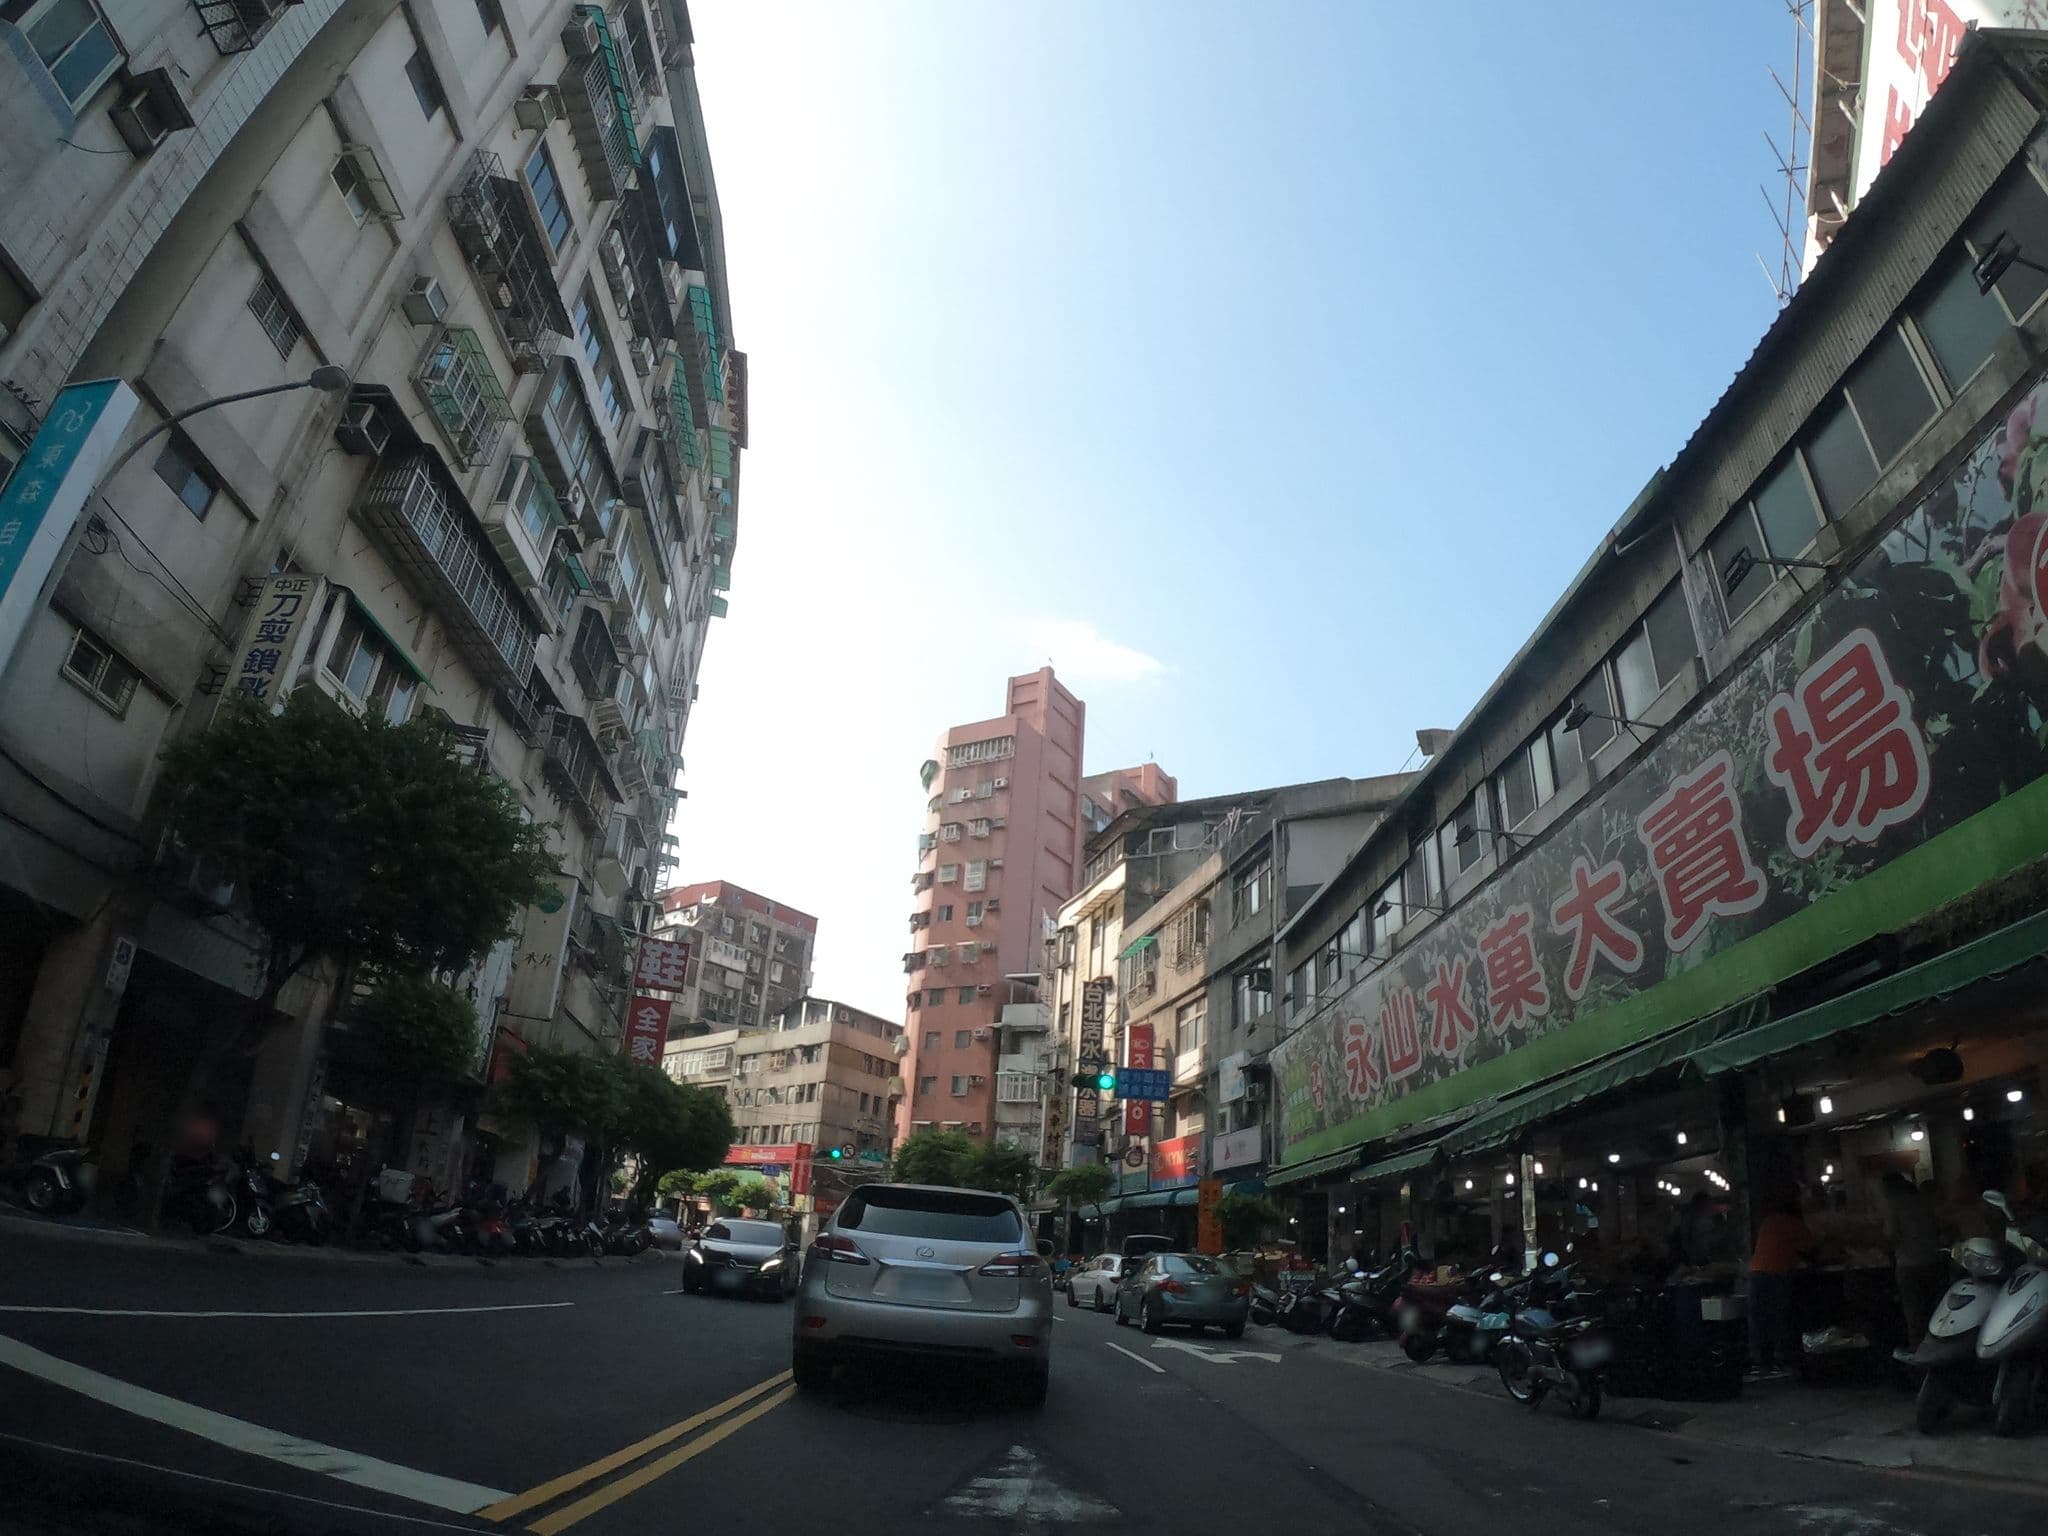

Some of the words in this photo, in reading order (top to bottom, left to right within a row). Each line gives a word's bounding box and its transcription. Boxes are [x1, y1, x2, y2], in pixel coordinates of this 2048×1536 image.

[275, 580, 310, 592] 中正
[1345, 634, 1926, 1098] 永山水菓大賣場
[637, 941, 686, 988] 鞋
[630, 1006, 661, 1061] 全家
